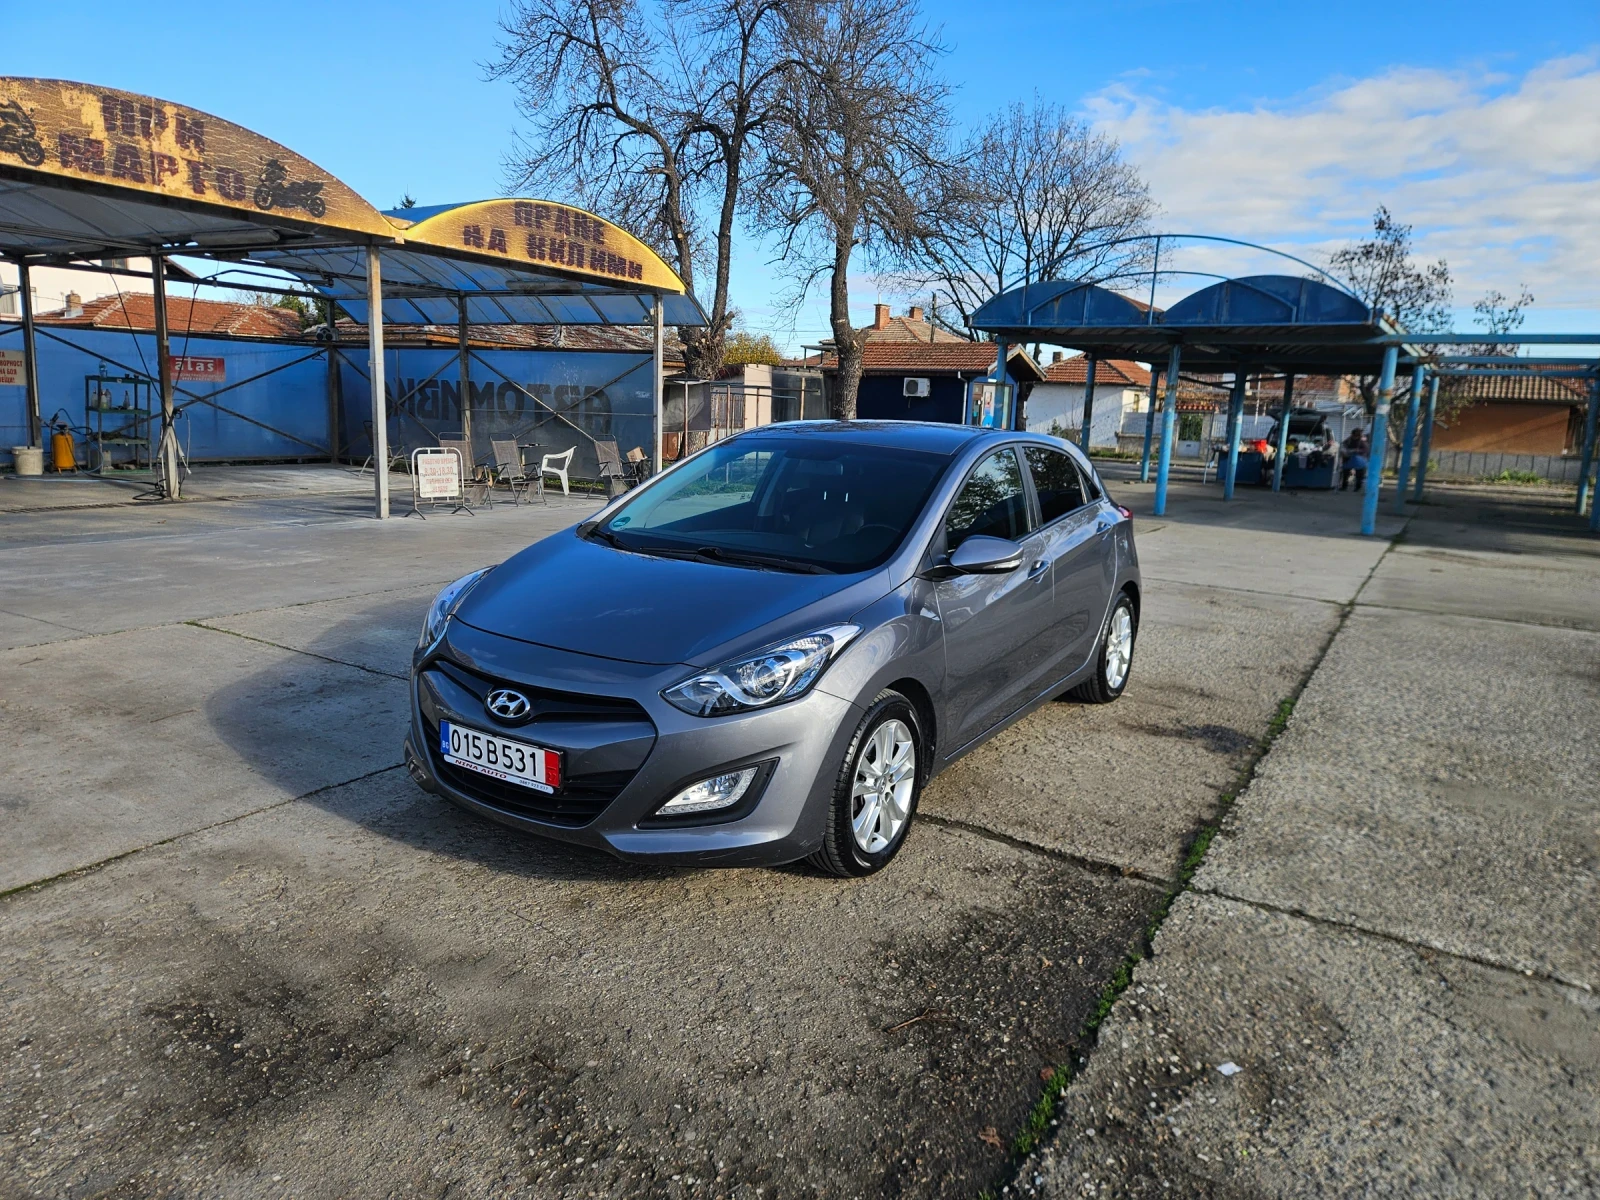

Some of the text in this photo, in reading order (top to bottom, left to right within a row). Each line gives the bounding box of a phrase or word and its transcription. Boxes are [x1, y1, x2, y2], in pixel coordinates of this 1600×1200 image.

[514, 200, 605, 246] ПРАНЕ
[463, 225, 508, 255] НА
[454, 759, 507, 779] NINA AUTO
